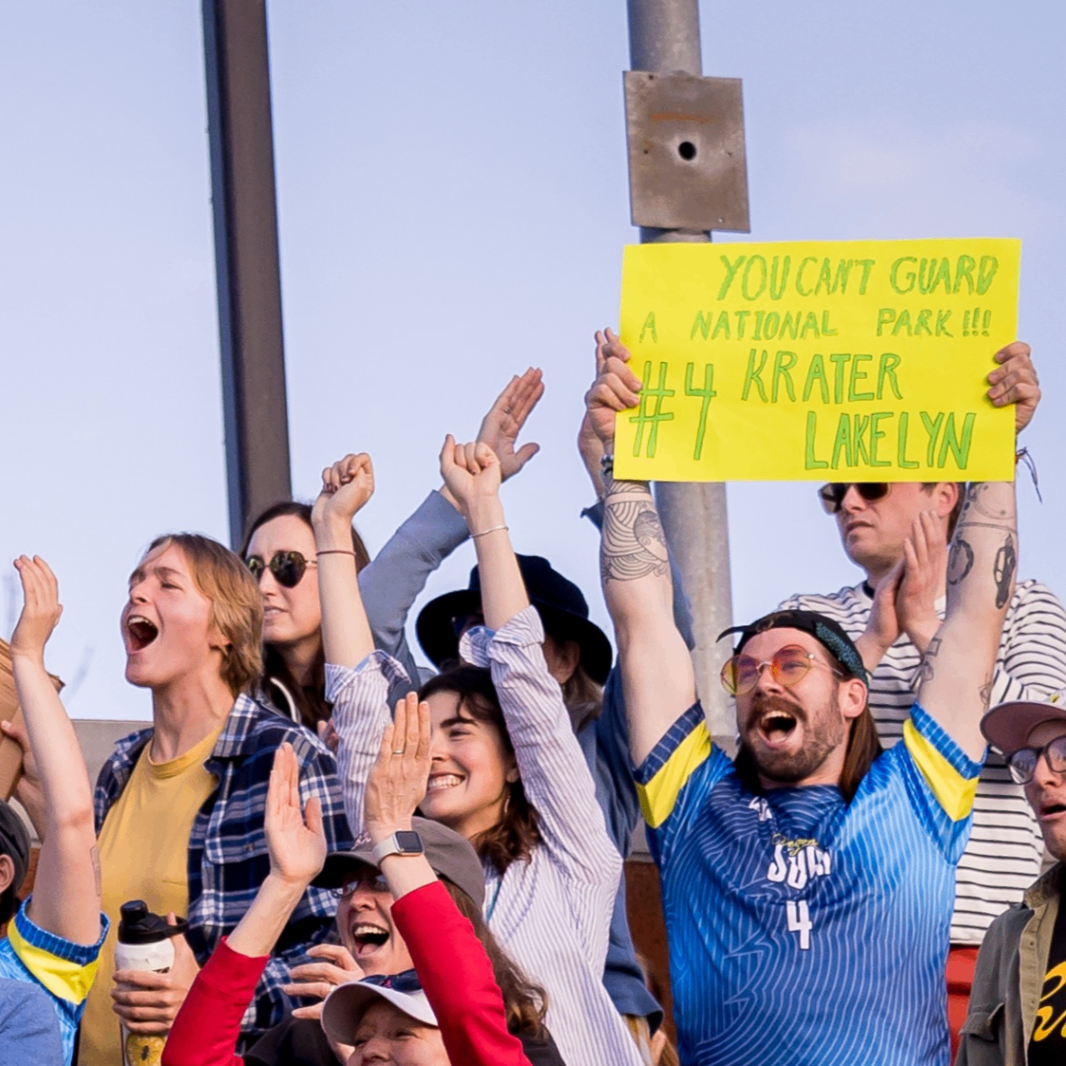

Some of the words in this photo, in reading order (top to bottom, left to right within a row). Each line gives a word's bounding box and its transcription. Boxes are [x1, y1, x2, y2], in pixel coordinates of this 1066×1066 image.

[717, 254, 791, 301] YOU
[889, 254, 999, 296] GUARD
[638, 310, 658, 344] A
[690, 309, 839, 342] NATIONAL
[629, 360, 718, 461] #4
[740, 348, 904, 404] KRATER
[804, 410, 976, 471] LAKELYN
[786, 899, 813, 950] 4
